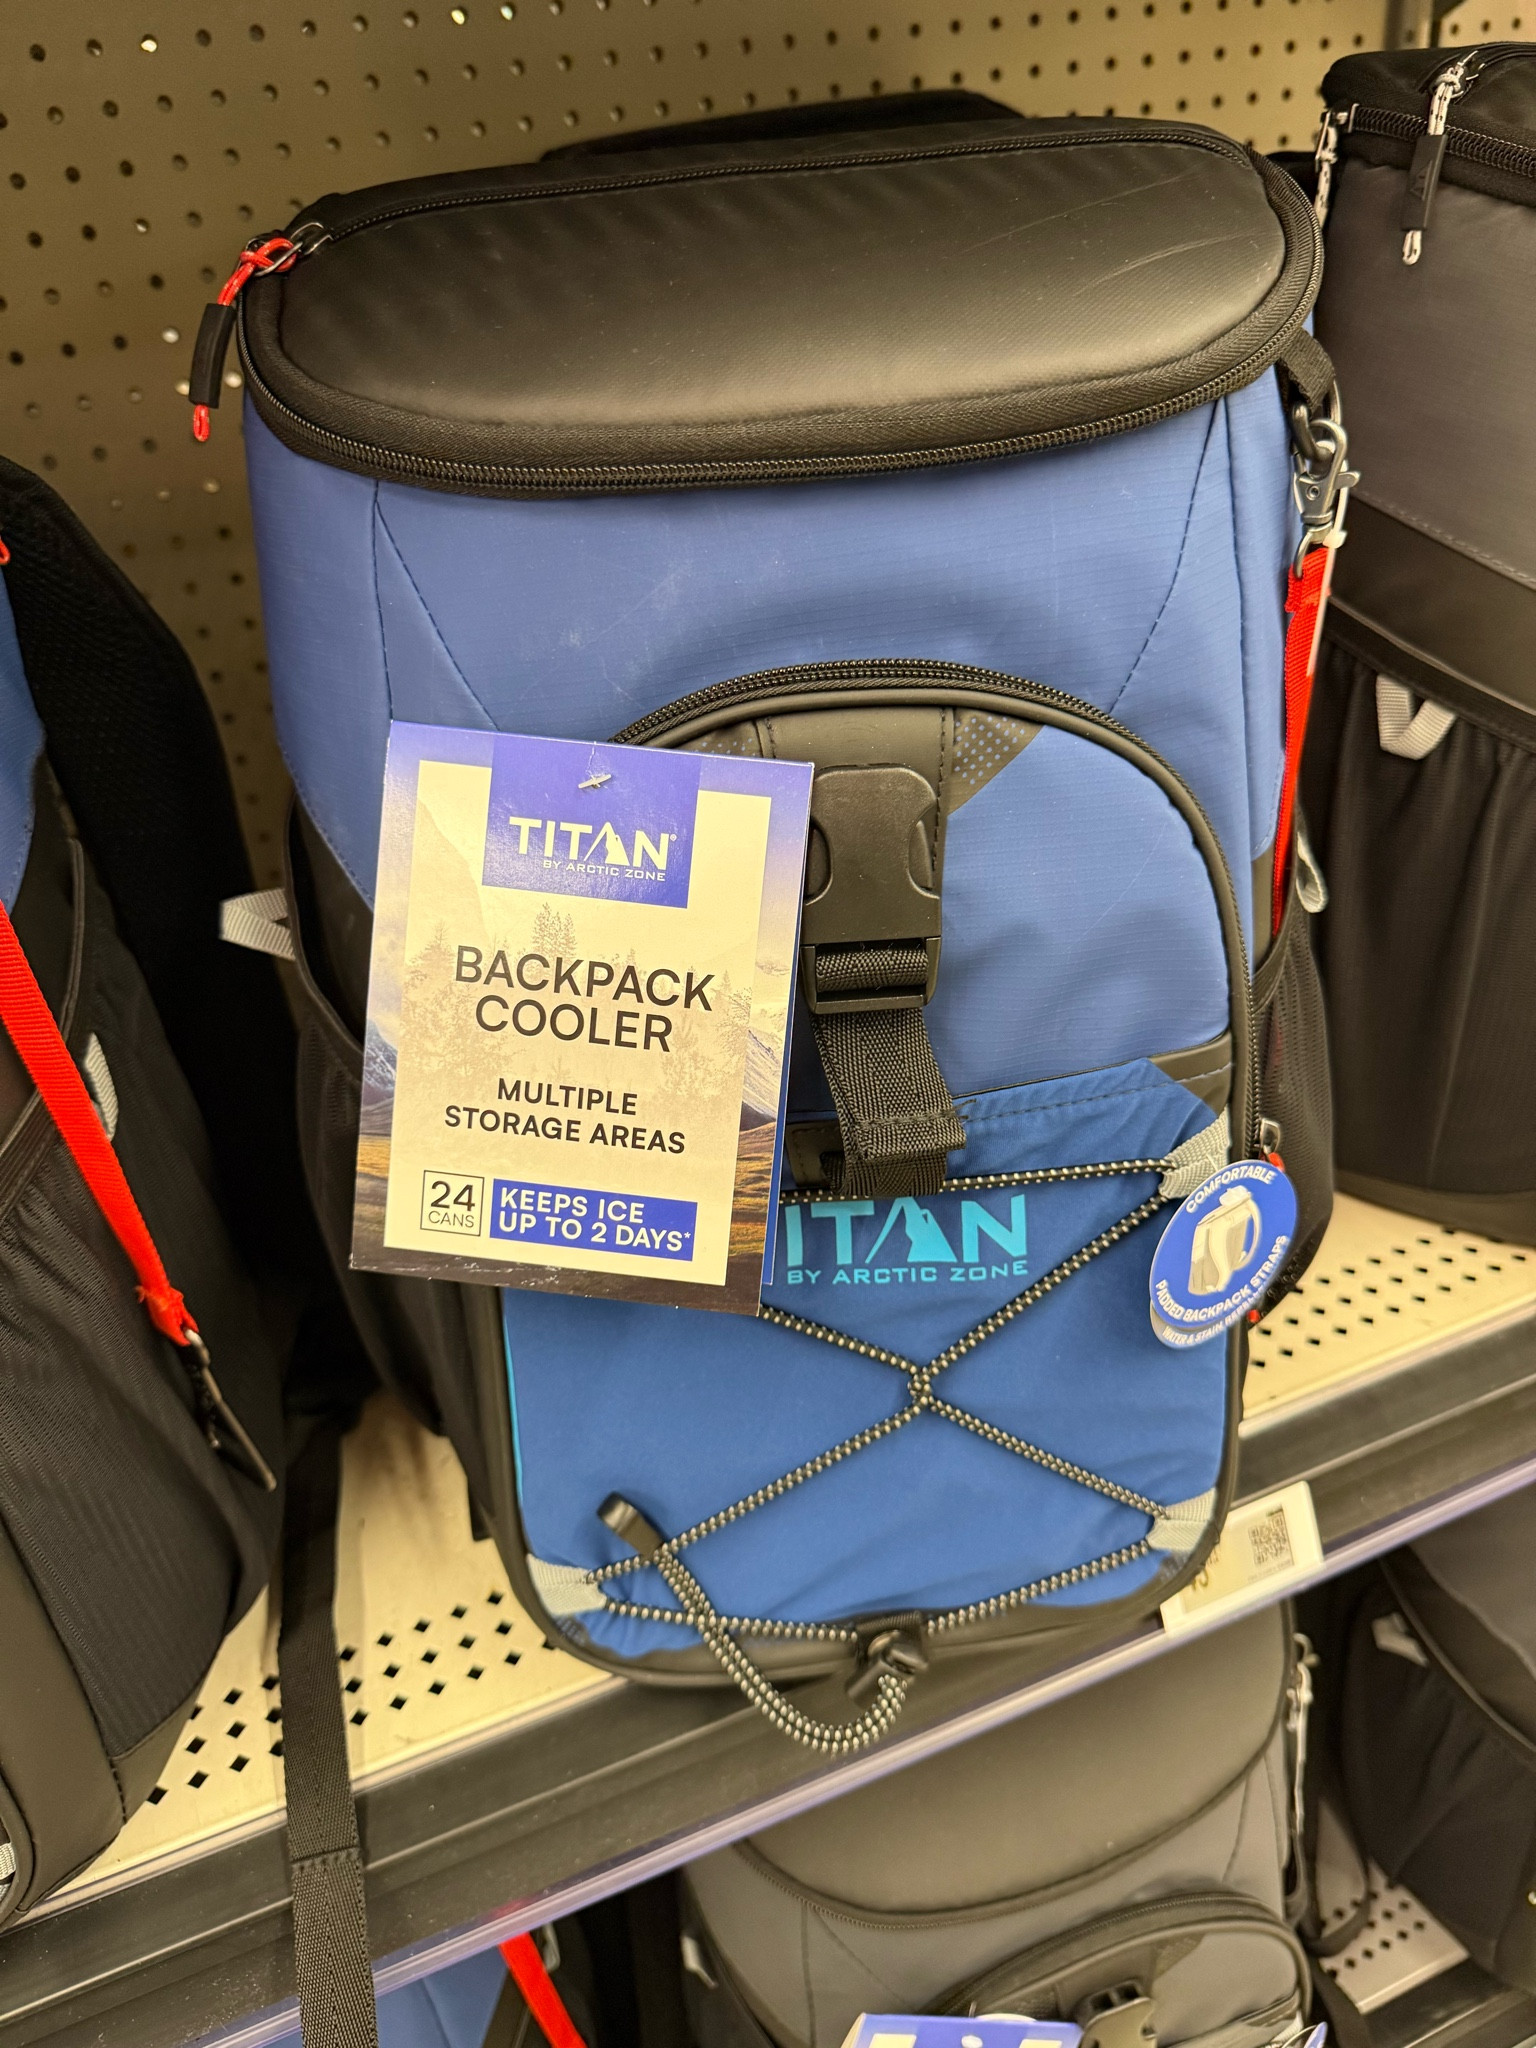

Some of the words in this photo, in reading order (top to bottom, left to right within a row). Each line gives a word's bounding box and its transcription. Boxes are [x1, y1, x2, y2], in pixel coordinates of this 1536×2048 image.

[543, 860, 561, 870] BY
[566, 862, 619, 877] ARCTIC
[625, 869, 666, 881] ZONE
[455, 945, 715, 1011] BACKPACK
[476, 995, 673, 1052] COOLER
[497, 1078, 638, 1116] MULTIPLE
[445, 1105, 581, 1142] STORAGE
[589, 1123, 685, 1154] AREAS
[430, 1180, 475, 1211] 24
[500, 1187, 588, 1217] KEEPS
[598, 1199, 645, 1223] ICE
[1186, 1165, 1278, 1214] COMFORTABLE
[428, 1211, 474, 1228] CANS
[499, 1211, 537, 1233] UP
[545, 1216, 583, 1239] TO
[591, 1222, 606, 1243] 2
[785, 1194, 1027, 1267] ITAN
[787, 1270, 821, 1284] BY
[832, 1267, 937, 1284] ARCTIC
[950, 1260, 1028, 1282] ZONE
[1156, 1279, 1185, 1321] PADDED
[1183, 1284, 1251, 1323] BACKPACK
[1250, 1235, 1290, 1287] STRAPS
